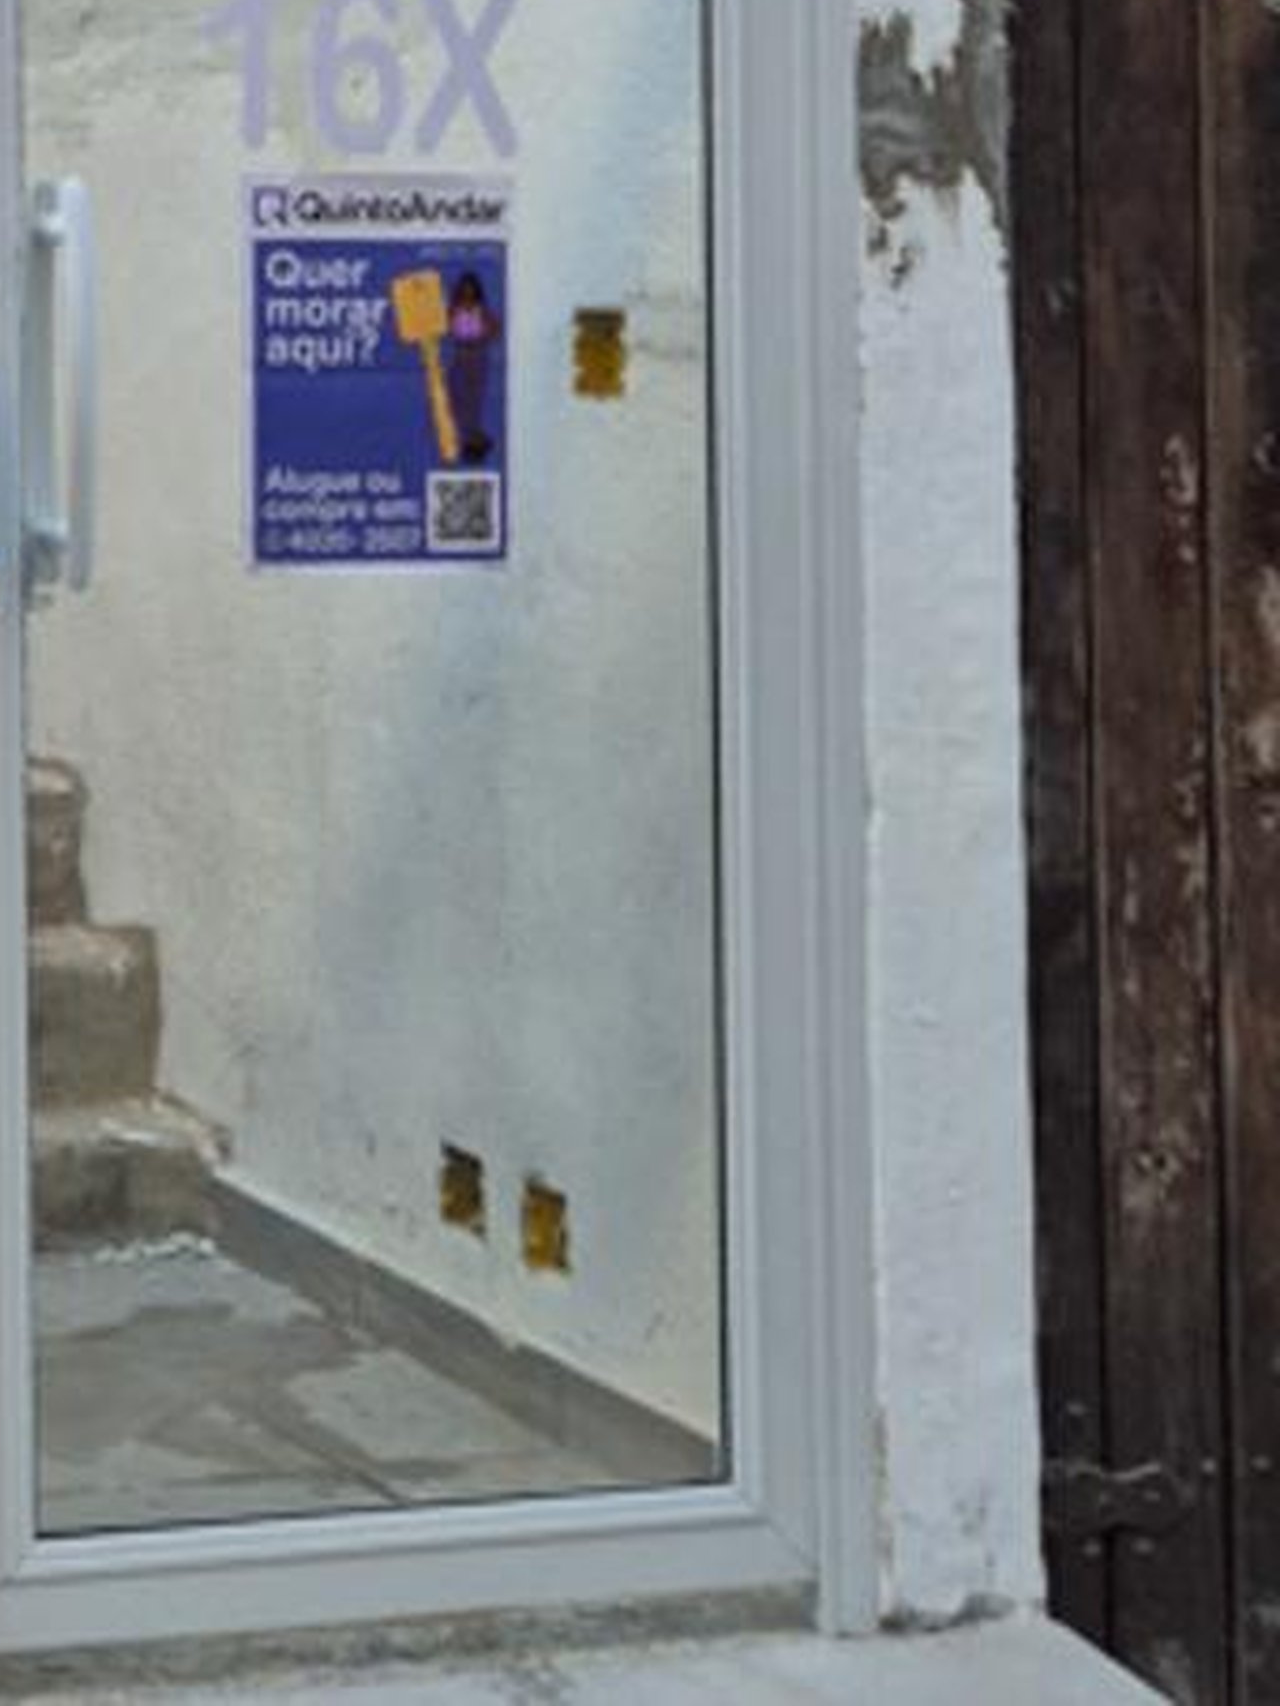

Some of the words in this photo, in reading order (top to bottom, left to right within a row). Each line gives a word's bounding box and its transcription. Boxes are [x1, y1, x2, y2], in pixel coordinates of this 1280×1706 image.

[293, 189, 504, 224] QuintoAndar
[266, 248, 371, 288] Quer
[266, 297, 388, 328] morar
[266, 328, 380, 373] aqui?
